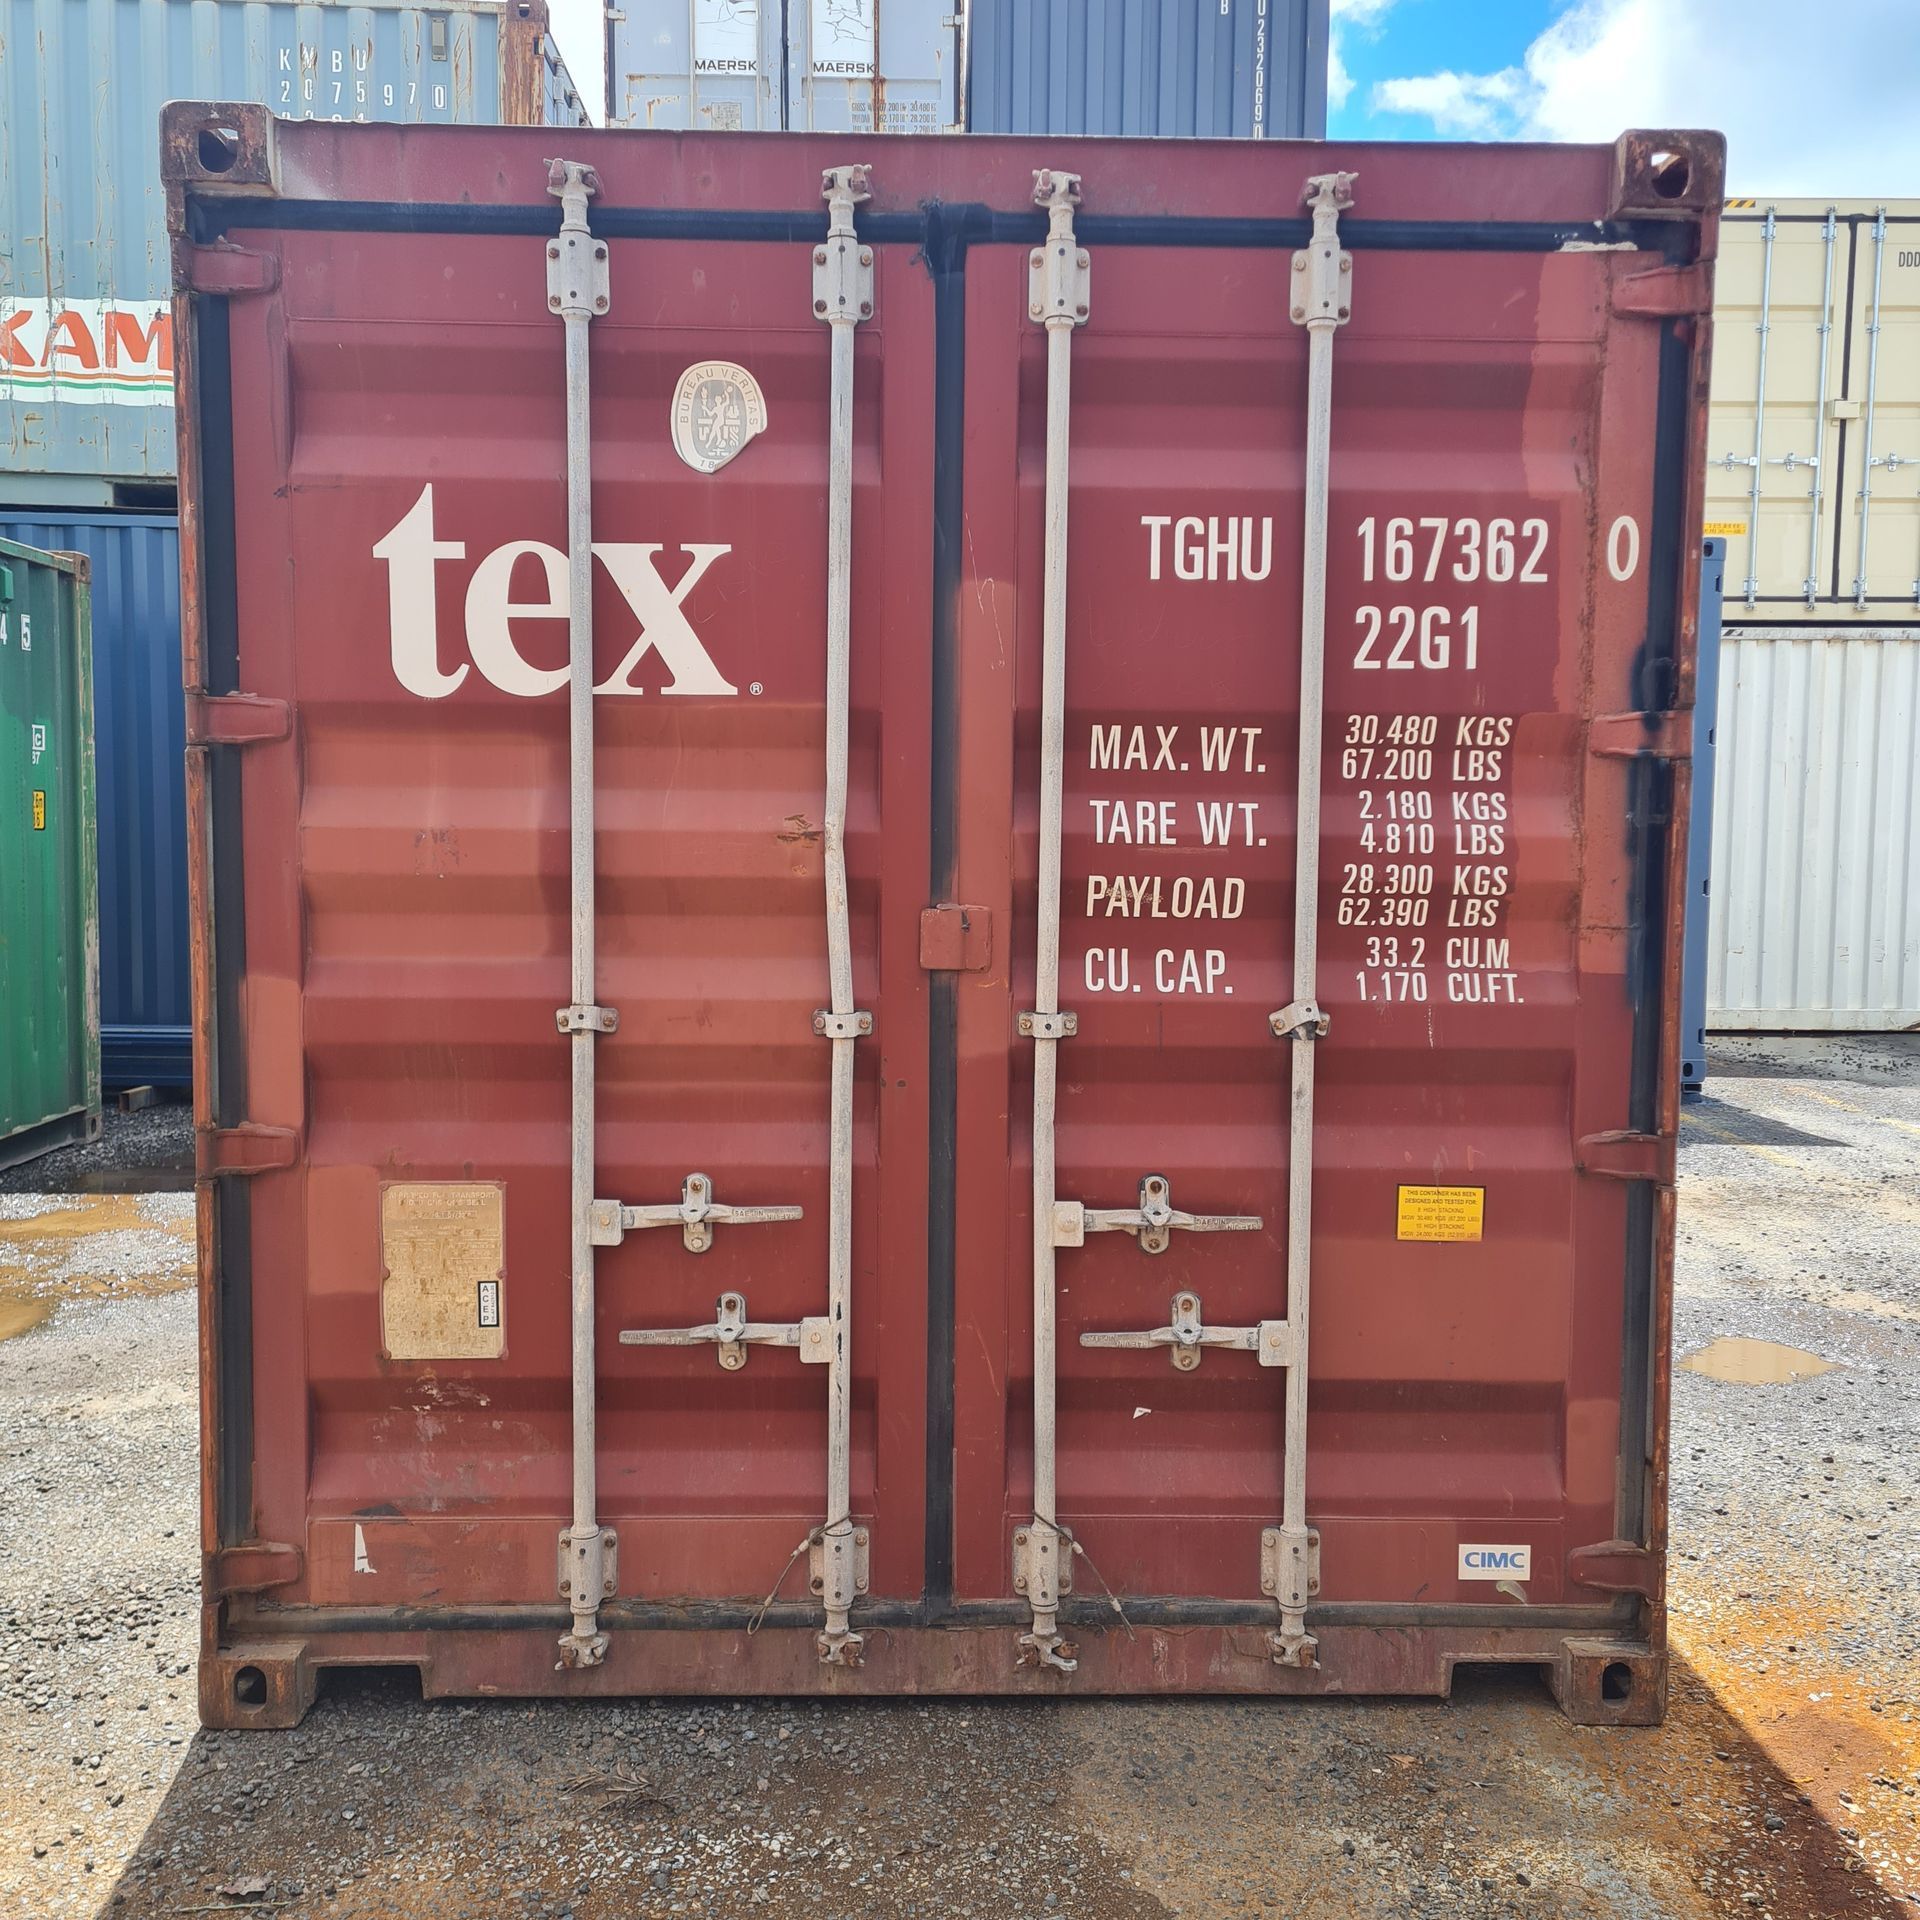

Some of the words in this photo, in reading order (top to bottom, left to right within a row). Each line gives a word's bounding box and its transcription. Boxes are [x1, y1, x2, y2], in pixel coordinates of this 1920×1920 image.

[695, 60, 757, 71] MAERSK
[813, 62, 876, 73] MAERSK
[680, 367, 714, 424] BUREAU
[721, 367, 759, 426] VERITAS
[1141, 516, 1273, 581] TGHU
[1357, 516, 1549, 583] 167362
[1607, 515, 1640, 582] 0
[372, 482, 739, 699] tex
[1353, 605, 1478, 670] 22G1
[1345, 715, 1438, 745] 30,480
[1455, 716, 1513, 746] KGS
[1090, 724, 1189, 772] MAX.
[1200, 726, 1267, 773] WT.
[1342, 748, 1433, 781] 67,200
[1452, 749, 1503, 782] LBS
[1358, 790, 1433, 820] 2,180
[1452, 791, 1507, 821] KGS
[1089, 799, 1177, 846] TARE
[1196, 801, 1268, 847] WT.
[1359, 822, 1435, 854] 4,810
[1455, 823, 1505, 855] LBS
[1341, 863, 1434, 895] 28,300
[1452, 864, 1509, 896] KGS
[1086, 875, 1246, 919] PAYLOAD
[1337, 897, 1430, 927] 62,390
[1447, 898, 1500, 928] LBS
[1365, 936, 1426, 968] 33.2
[1446, 937, 1511, 970] CU.M
[1084, 947, 1142, 994] CU.
[1154, 948, 1234, 995] CAP.
[1356, 971, 1428, 1002] 1,170
[482, 1284, 490, 1323] ACEP
[1464, 1552, 1525, 1568] CIMC
